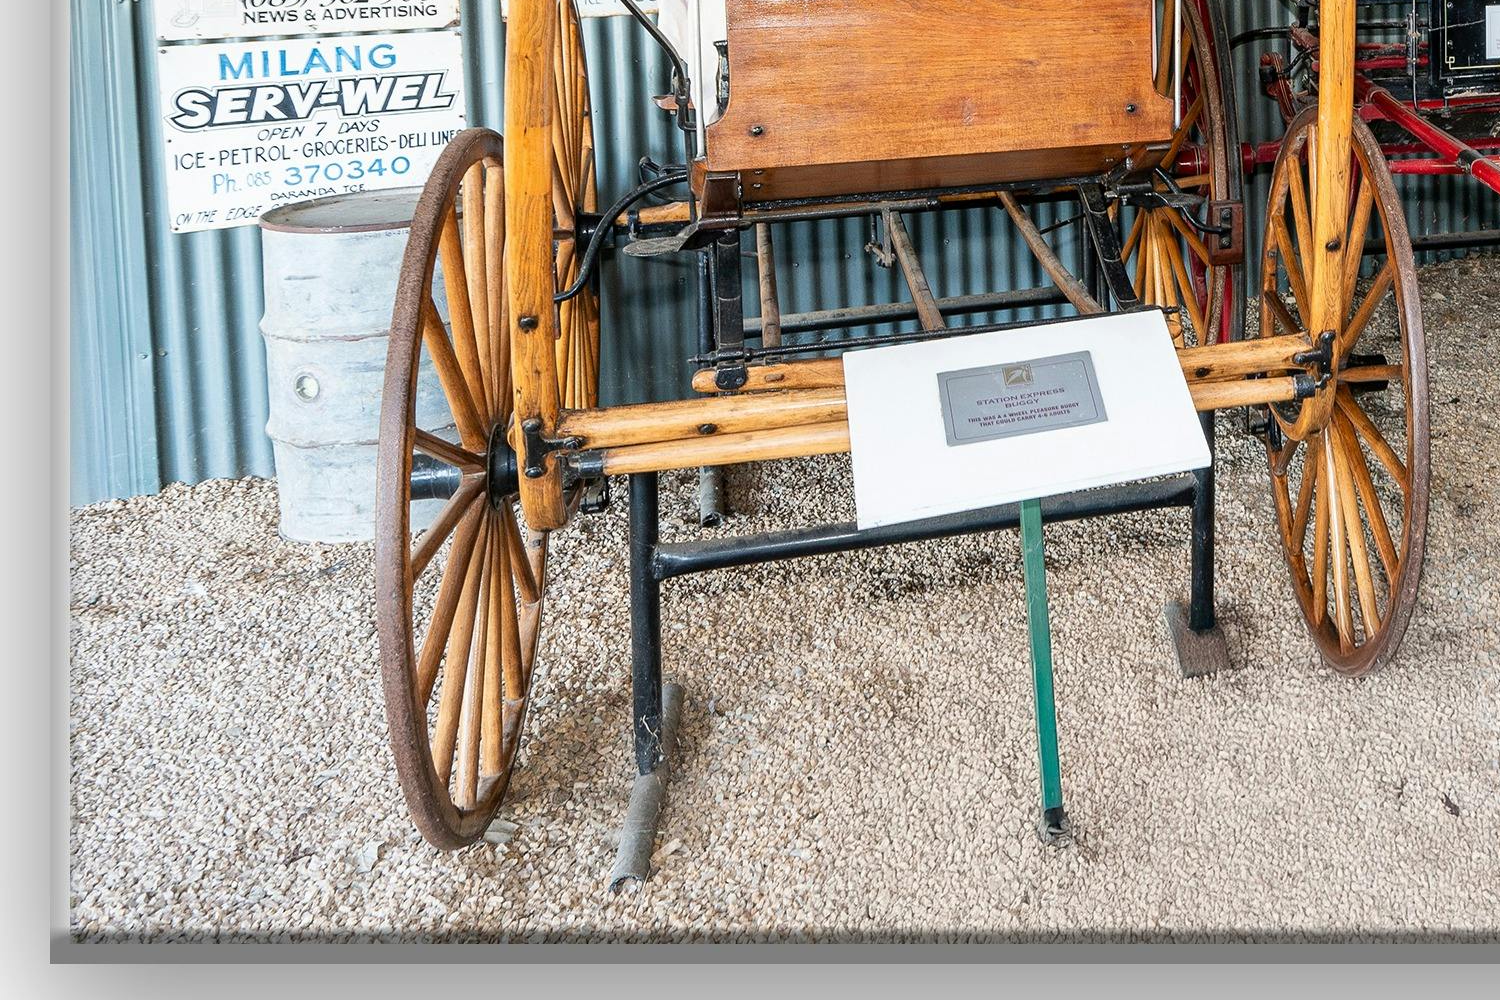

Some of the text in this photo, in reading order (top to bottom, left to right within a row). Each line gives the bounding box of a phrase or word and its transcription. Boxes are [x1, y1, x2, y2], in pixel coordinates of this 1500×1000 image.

[243, 4, 438, 24] NEWS & ADVERTISING
[218, 43, 397, 81] MILANG
[167, 71, 458, 130] SERV-WEL
[257, 119, 381, 141] OPEN 7 DAYS
[246, 171, 272, 187] 085
[284, 156, 411, 187] 370340
[176, 213, 192, 226] ON
[194, 209, 218, 223] THE
[226, 205, 263, 221] EDGE
[976, 386, 1065, 406] STATION EXPRESS
[1005, 398, 1040, 409] BUGGY
